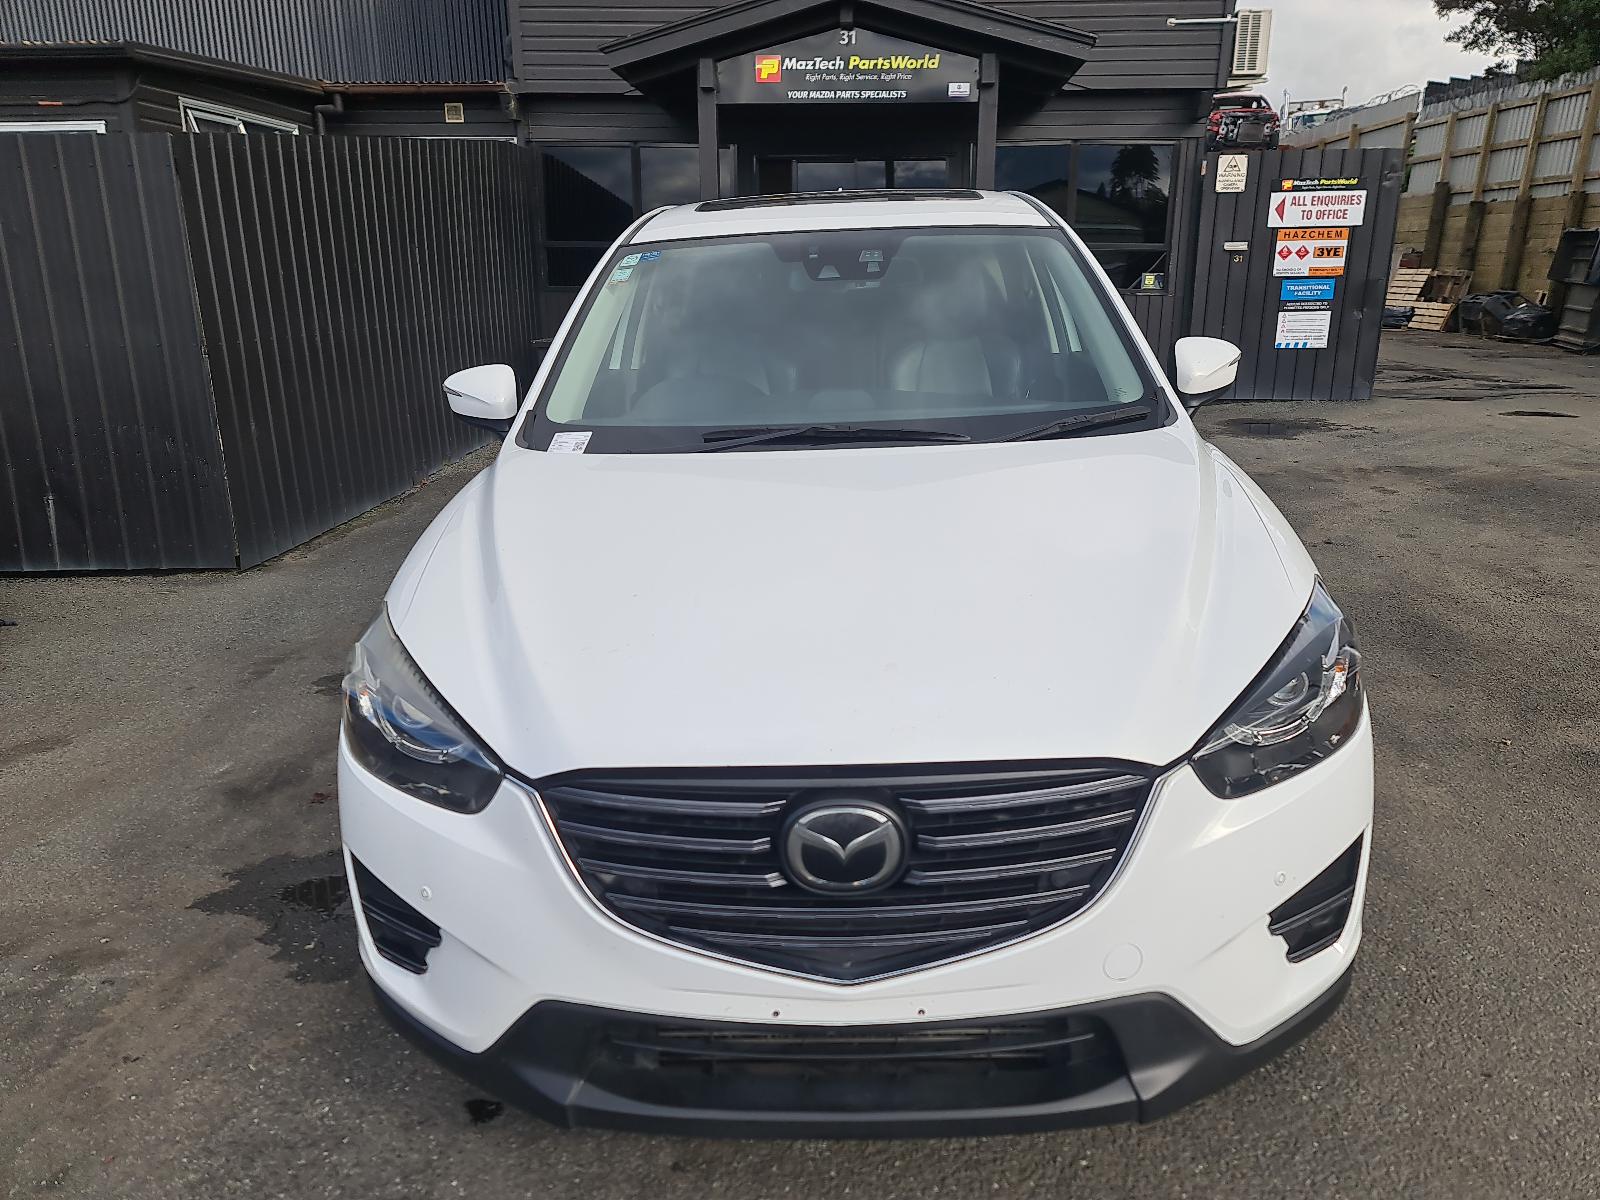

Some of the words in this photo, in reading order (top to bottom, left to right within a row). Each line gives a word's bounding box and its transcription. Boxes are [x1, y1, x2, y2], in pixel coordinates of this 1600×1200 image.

[839, 30, 856, 44] 31
[782, 56, 844, 70] MazTech
[848, 54, 941, 70] PartsWorld
[805, 73, 821, 81] Right
[839, 73, 855, 81] Right
[880, 72, 896, 81] Right
[896, 72, 913, 80] Price
[787, 91, 808, 99] YOUR
[809, 91, 835, 99] MAZDA
[836, 91, 860, 99] PARTS
[861, 90, 907, 99] SPECIALISTS
[1290, 195, 1308, 206] ALL
[1310, 194, 1363, 207] ENQUIRIES
[1300, 209, 1313, 220] TO
[1315, 208, 1349, 220] OFFICE
[1283, 230, 1343, 239] HAZCHEM
[1316, 247, 1341, 257] 3YE
